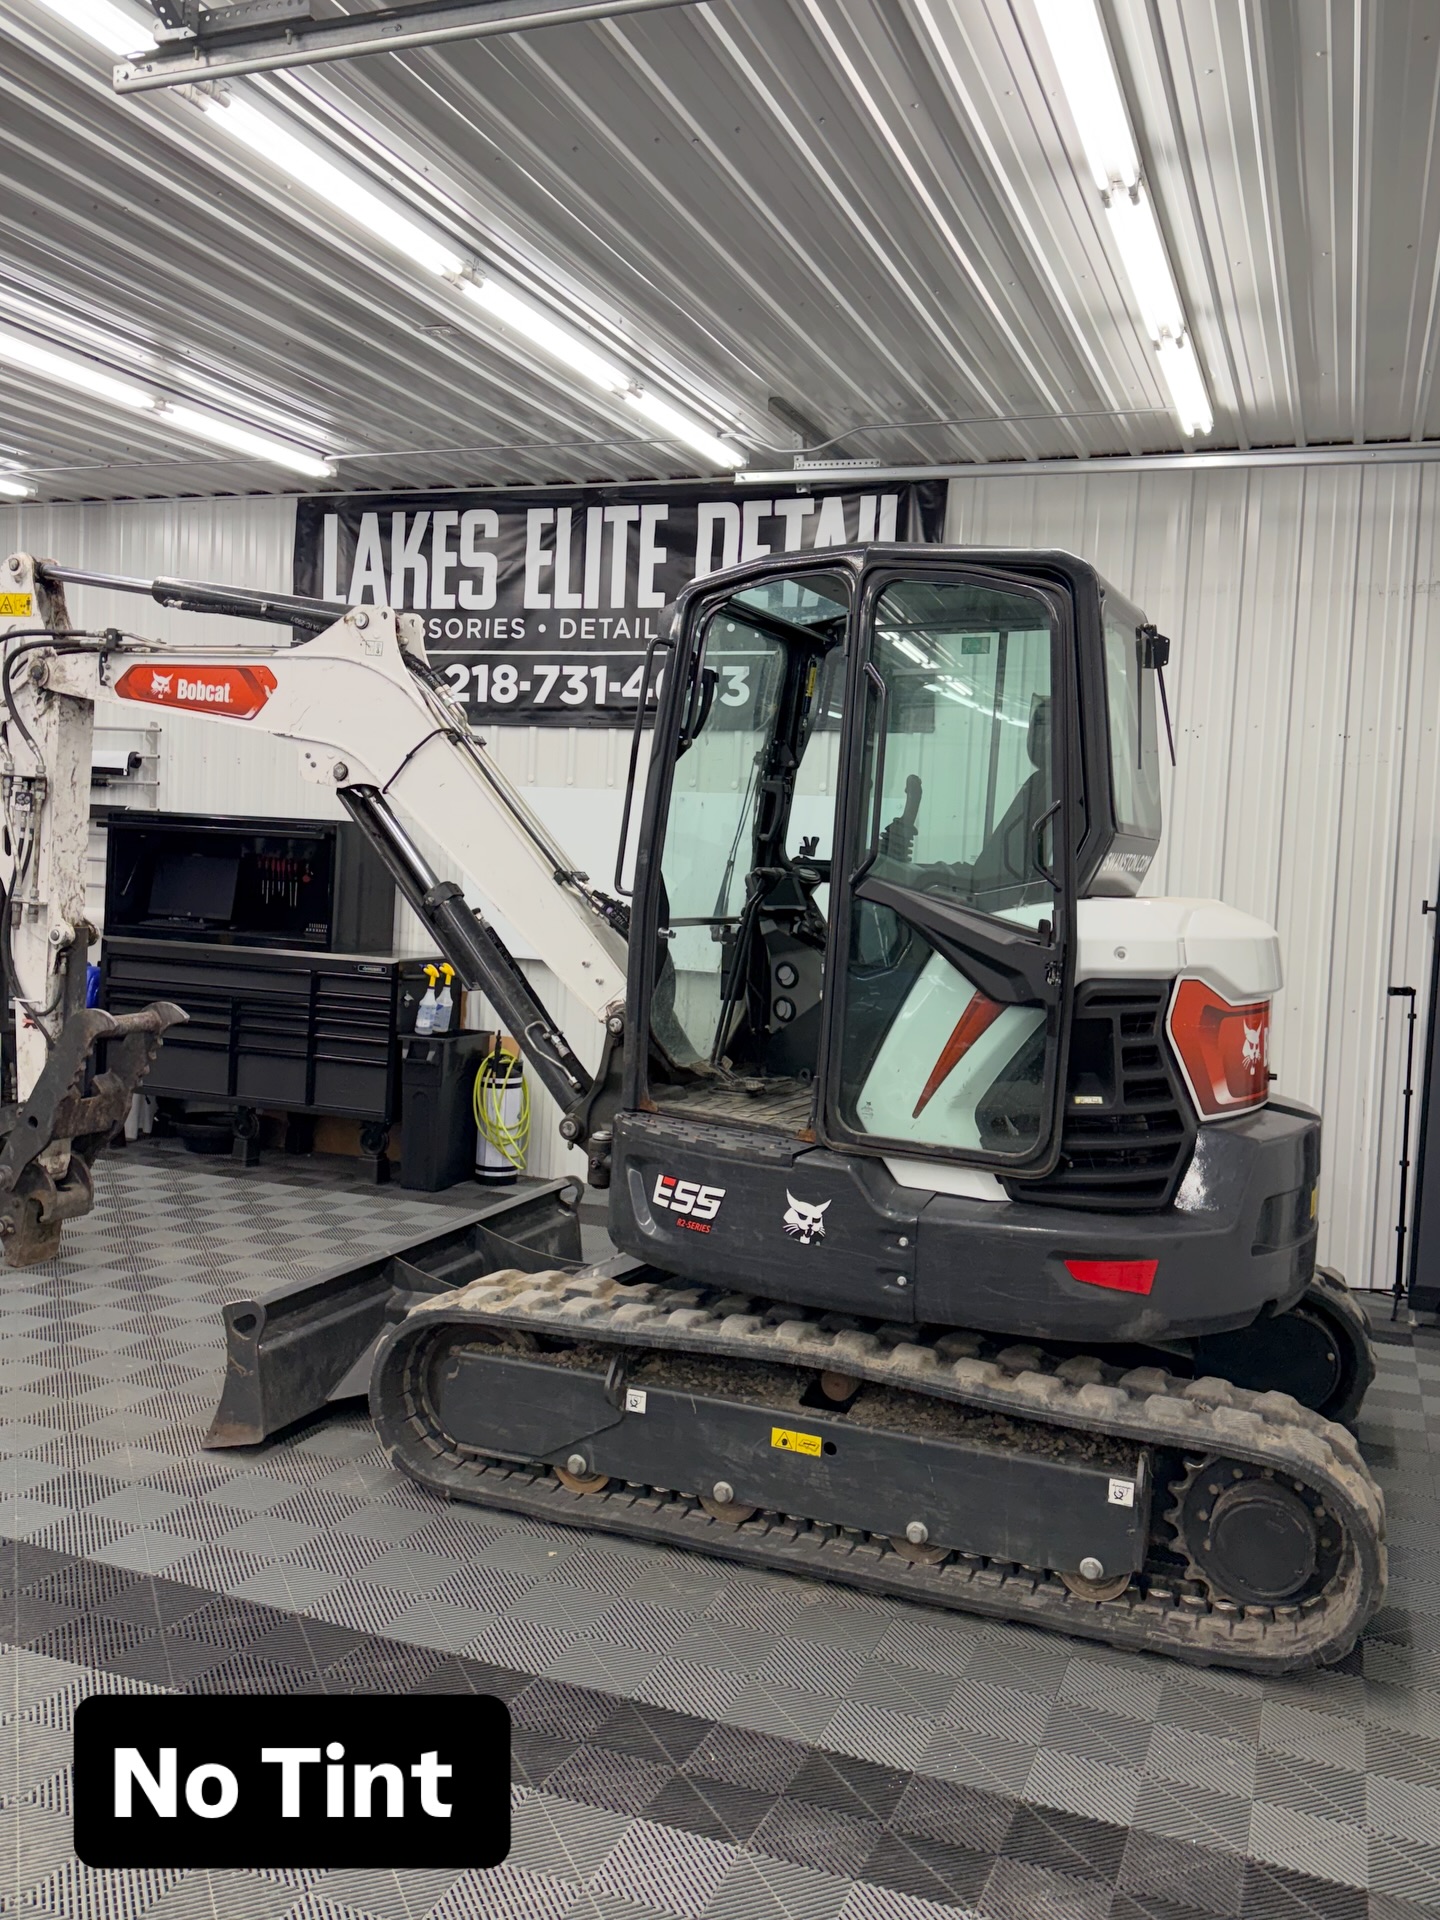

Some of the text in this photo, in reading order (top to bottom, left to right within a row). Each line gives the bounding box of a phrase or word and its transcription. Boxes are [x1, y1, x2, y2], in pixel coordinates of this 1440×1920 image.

[323, 508, 499, 611] LAKES
[523, 502, 669, 609] ELITE
[422, 617, 526, 639] SORIES
[177, 679, 230, 703] Bobcat
[676, 1217, 712, 1233] R2-SERIES
